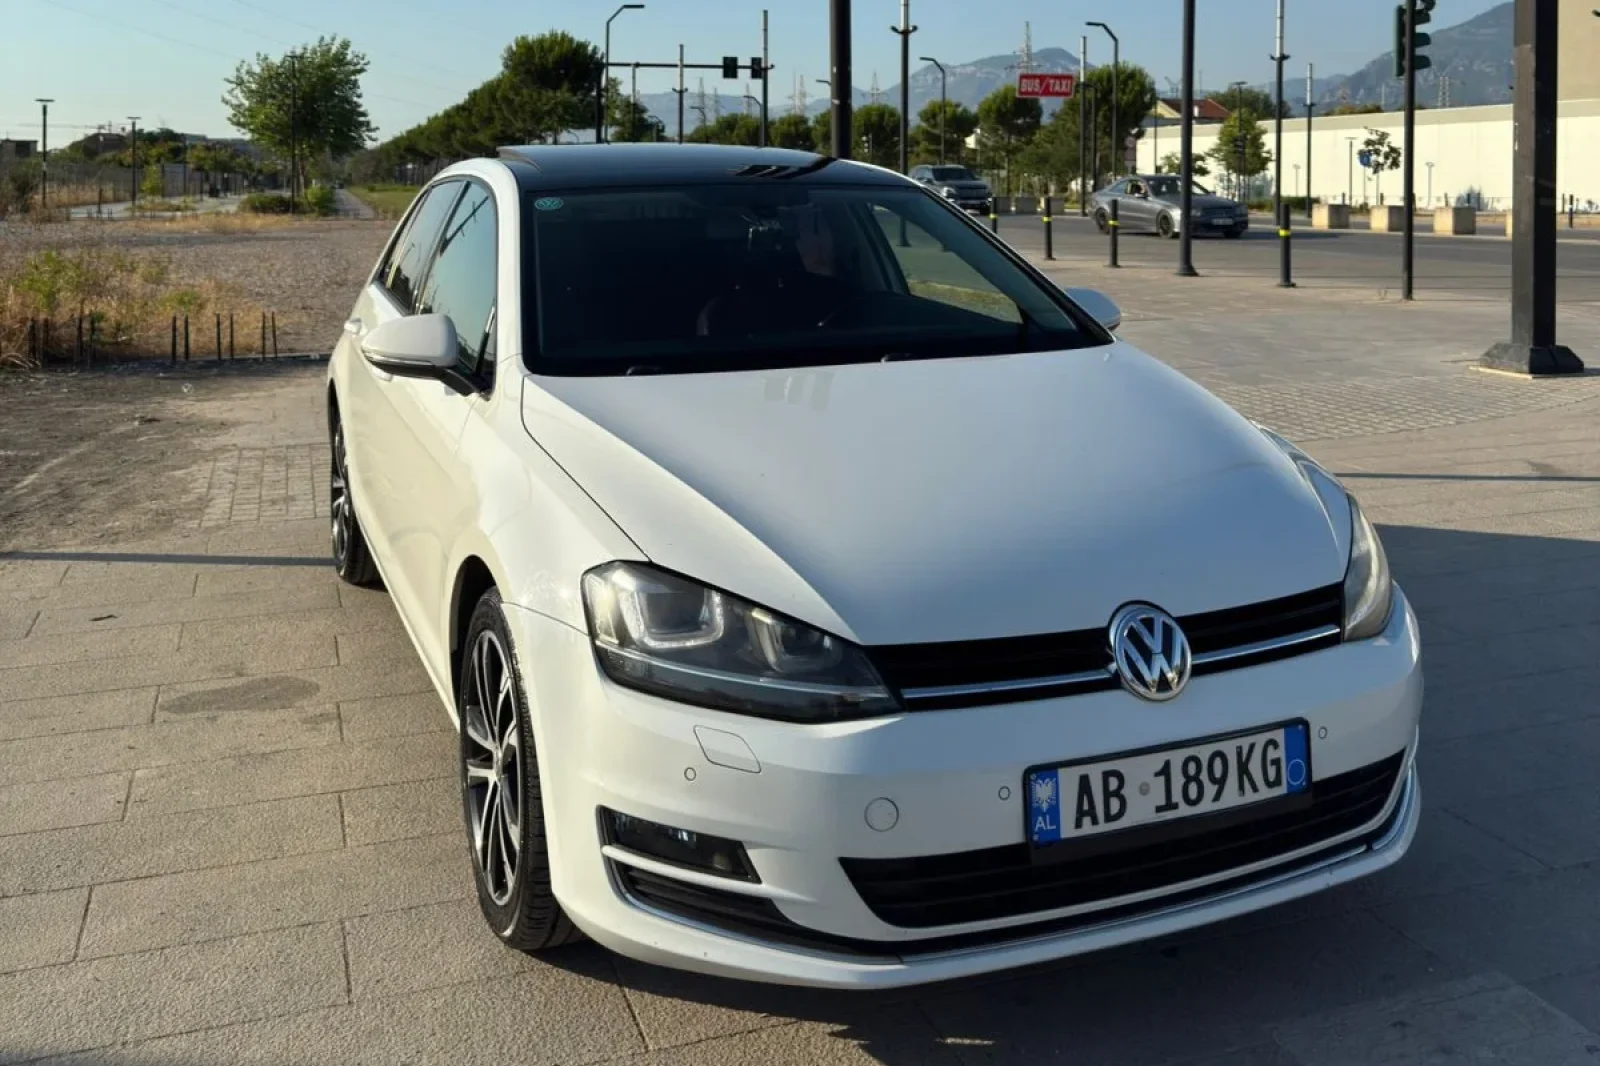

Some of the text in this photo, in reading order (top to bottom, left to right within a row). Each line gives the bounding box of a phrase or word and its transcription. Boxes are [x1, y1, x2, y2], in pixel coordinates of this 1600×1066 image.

[1112, 605, 1189, 699] VW
[1035, 814, 1056, 832] AL
[1074, 769, 1128, 829] AB
